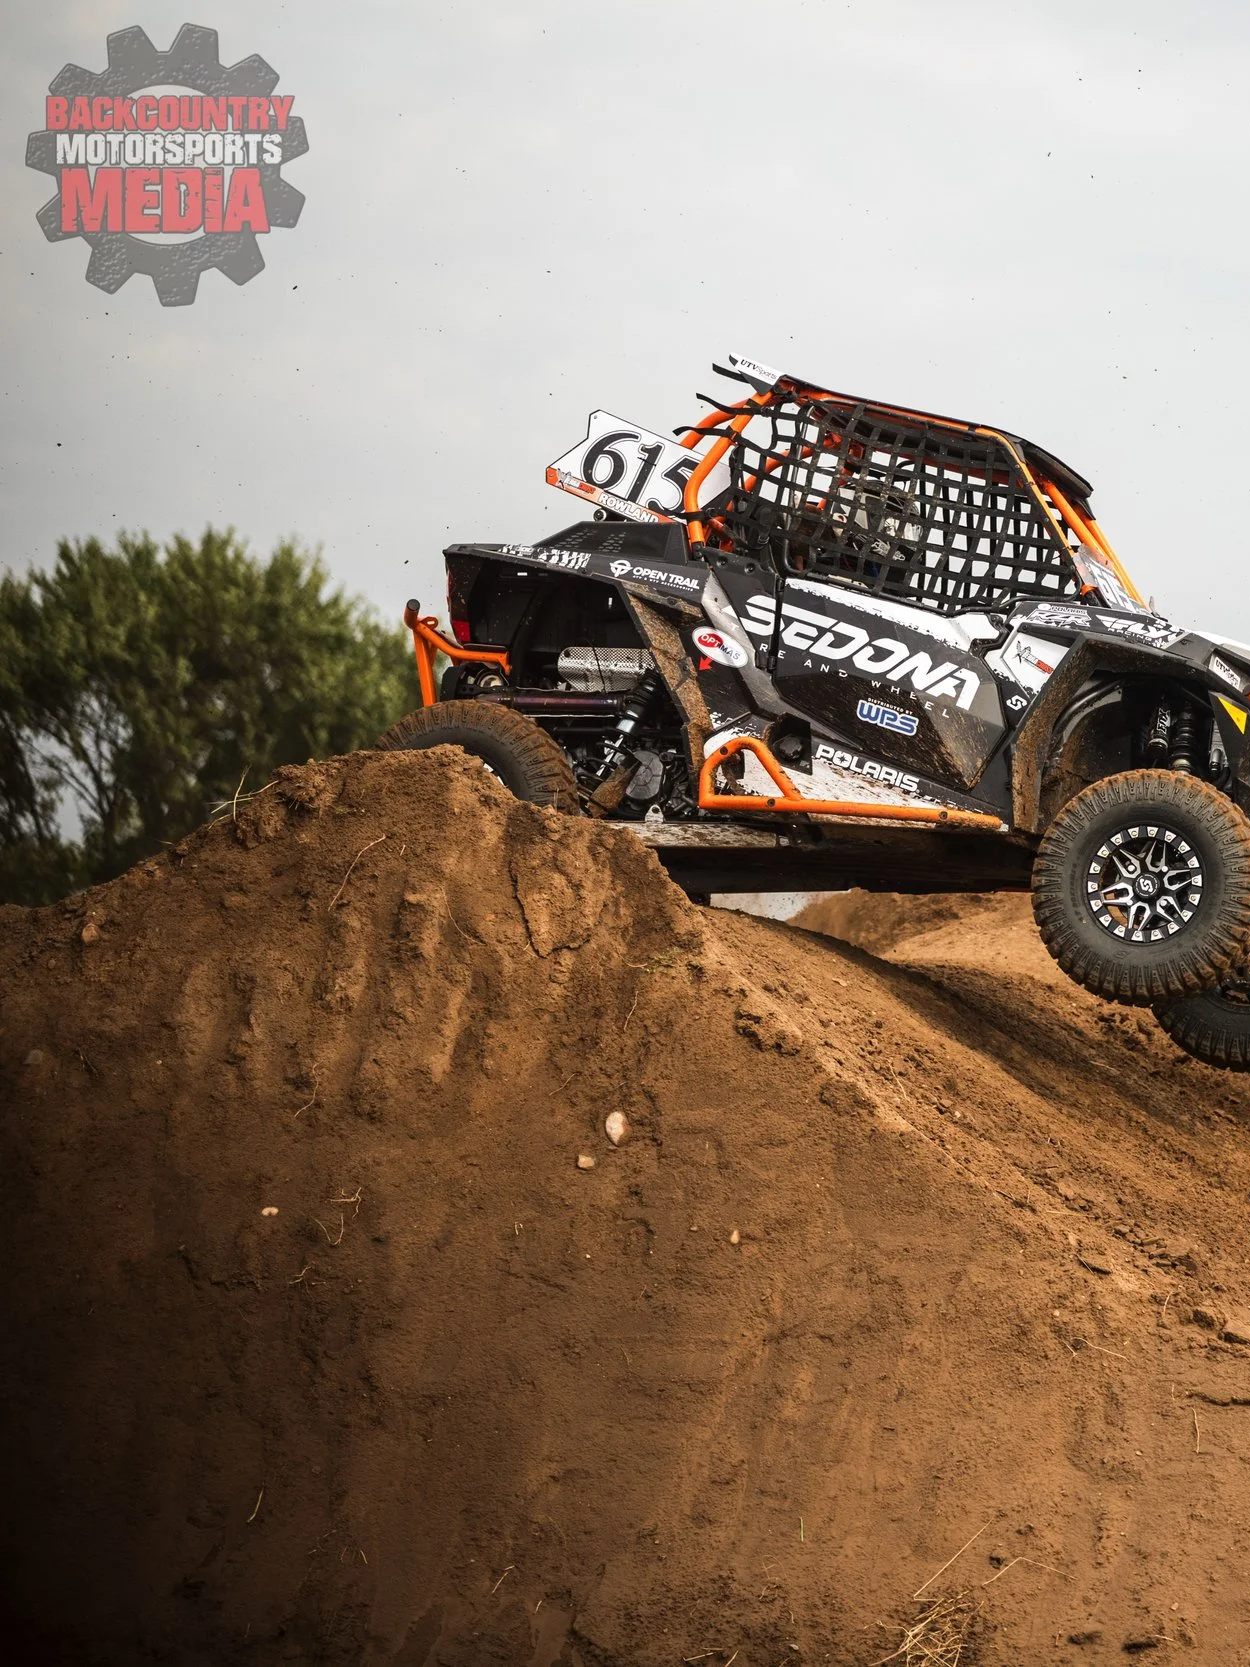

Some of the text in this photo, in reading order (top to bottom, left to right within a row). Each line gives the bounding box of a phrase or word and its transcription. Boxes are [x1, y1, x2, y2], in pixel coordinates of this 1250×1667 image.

[581, 430, 701, 514] 615
[599, 491, 659, 522] ROWLAND
[633, 566, 700, 589] OPEN TRAIL
[700, 633, 741, 660] OPTIMAS
[721, 594, 980, 711] SEDONA
[804, 659, 848, 679] AND
[871, 679, 950, 719] WHEEL
[867, 697, 904, 713] DISTRIBUTED
[856, 699, 920, 737] WPS
[815, 743, 920, 794] POLARIS
